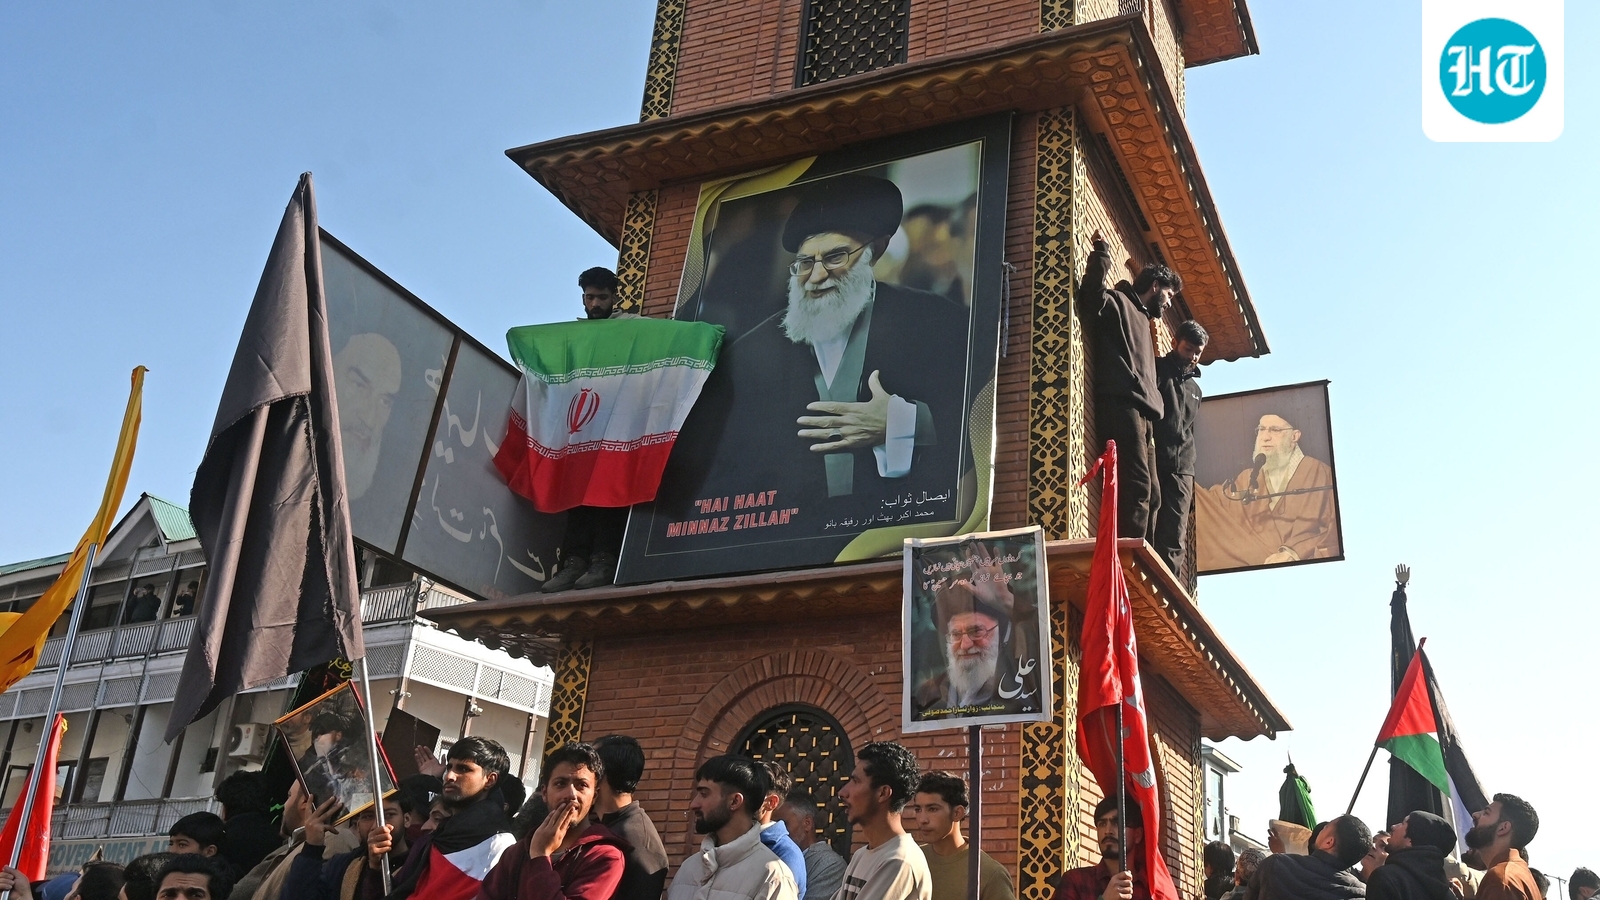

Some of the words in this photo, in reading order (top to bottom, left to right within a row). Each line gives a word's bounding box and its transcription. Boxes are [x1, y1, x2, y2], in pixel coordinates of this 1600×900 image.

[694, 495, 728, 515] "HAI
[734, 489, 777, 511] HAAT
[666, 516, 729, 538] MINNAZ
[733, 507, 799, 529] ZILLAH"
[861, 515, 875, 526] اور
[896, 509, 912, 522] اکبر
[824, 521, 838, 530] بانو
[998, 654, 1037, 699] علی
